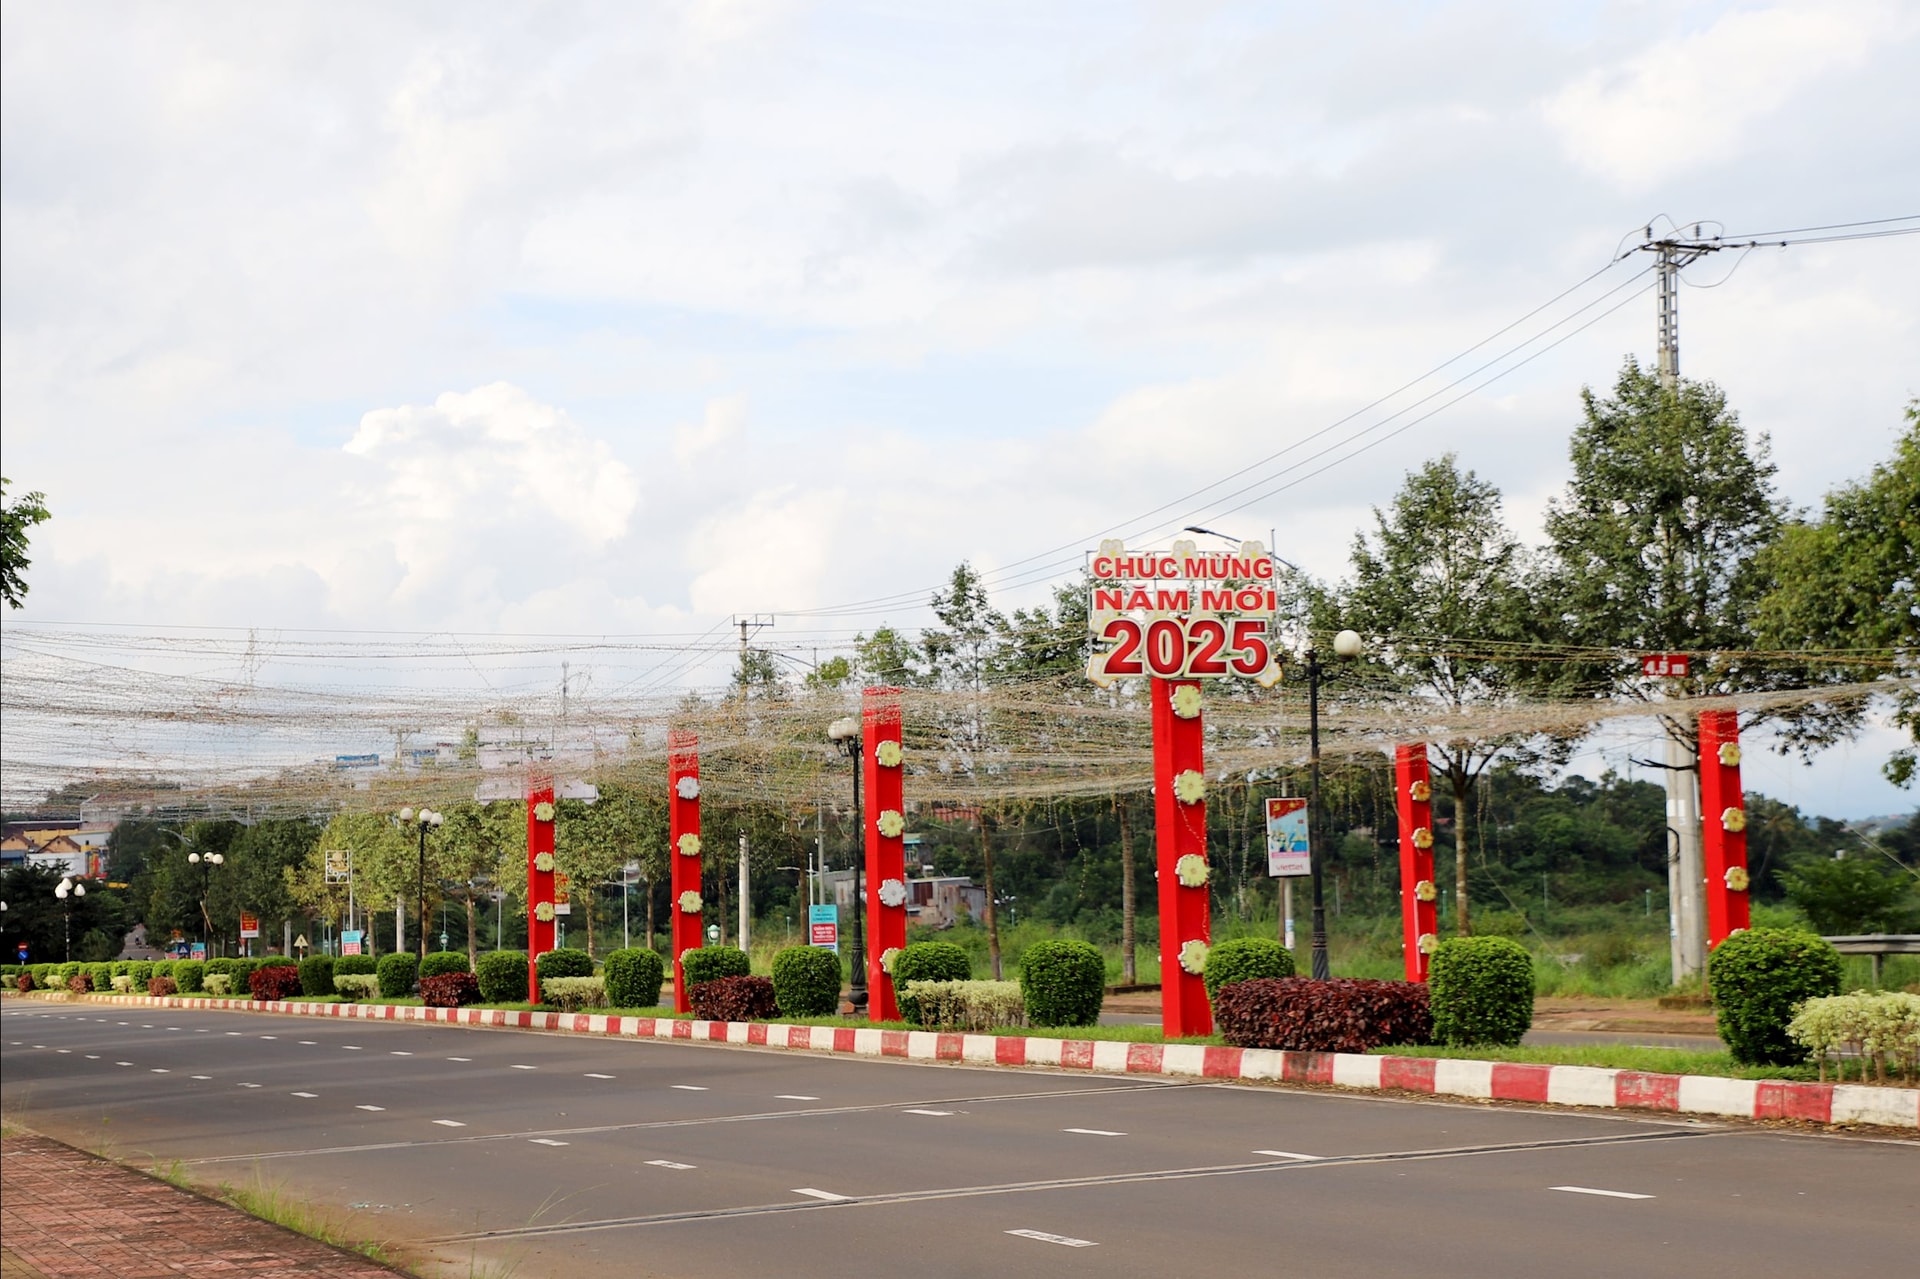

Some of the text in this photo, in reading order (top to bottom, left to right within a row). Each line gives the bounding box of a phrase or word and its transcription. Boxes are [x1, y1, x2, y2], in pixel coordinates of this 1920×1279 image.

[1093, 553, 1272, 579] CHÚC MỪNG
[1095, 586, 1276, 611] NĂM MỚI
[1103, 619, 1268, 675] 2025
[1671, 664, 1685, 675] m
